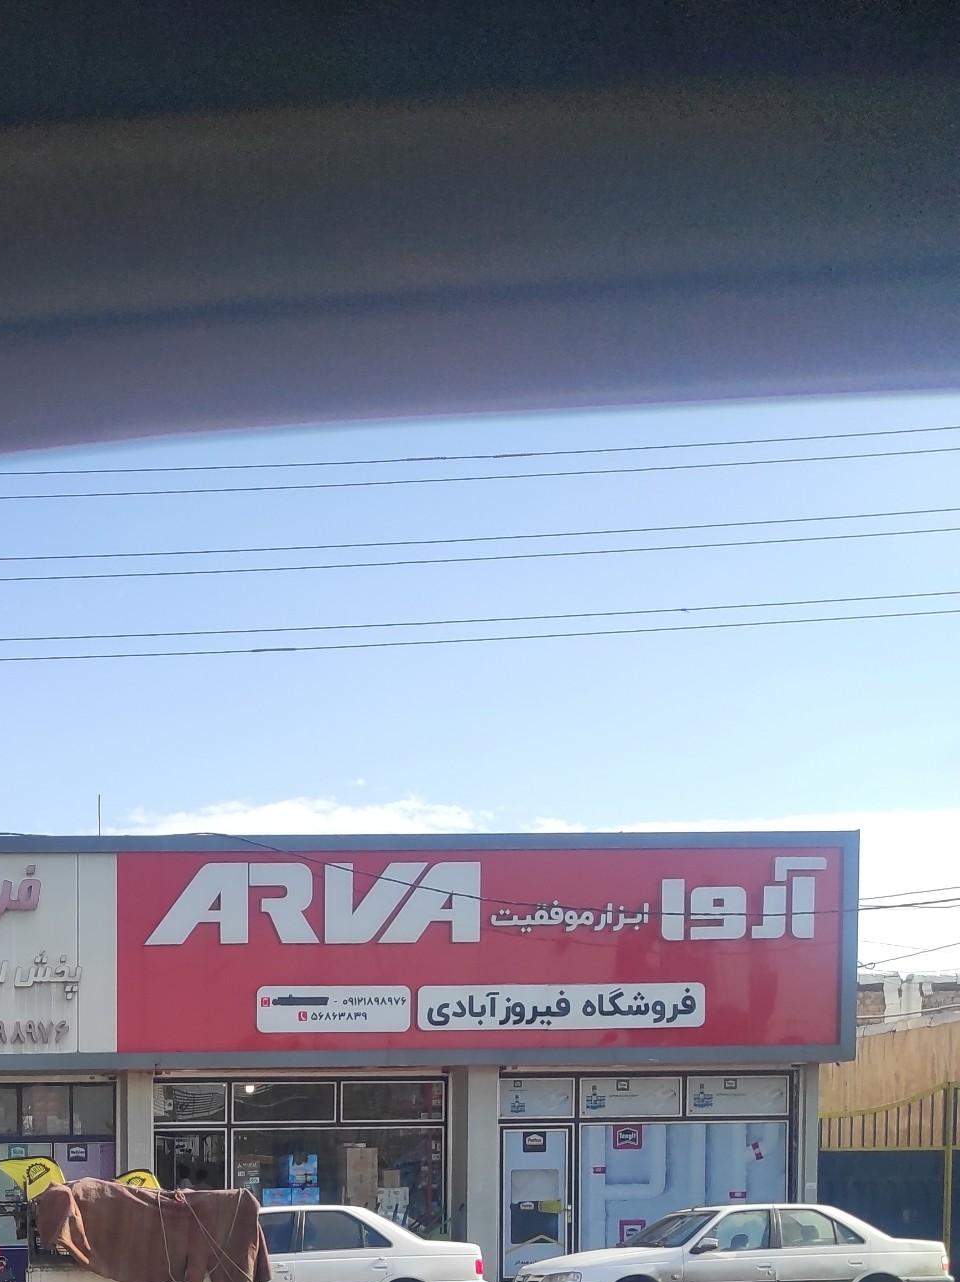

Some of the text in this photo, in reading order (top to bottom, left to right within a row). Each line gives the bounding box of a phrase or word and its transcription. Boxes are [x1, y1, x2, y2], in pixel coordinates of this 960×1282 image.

[143, 861, 481, 946] ARVA
[661, 856, 828, 942] آروا
[13, 951, 83, 1000] پخش
[310, 1010, 368, 1021] ۵۶۸۶۳۸۳۹
[426, 987, 696, 1027] فروشگاه فیروزآبادی
